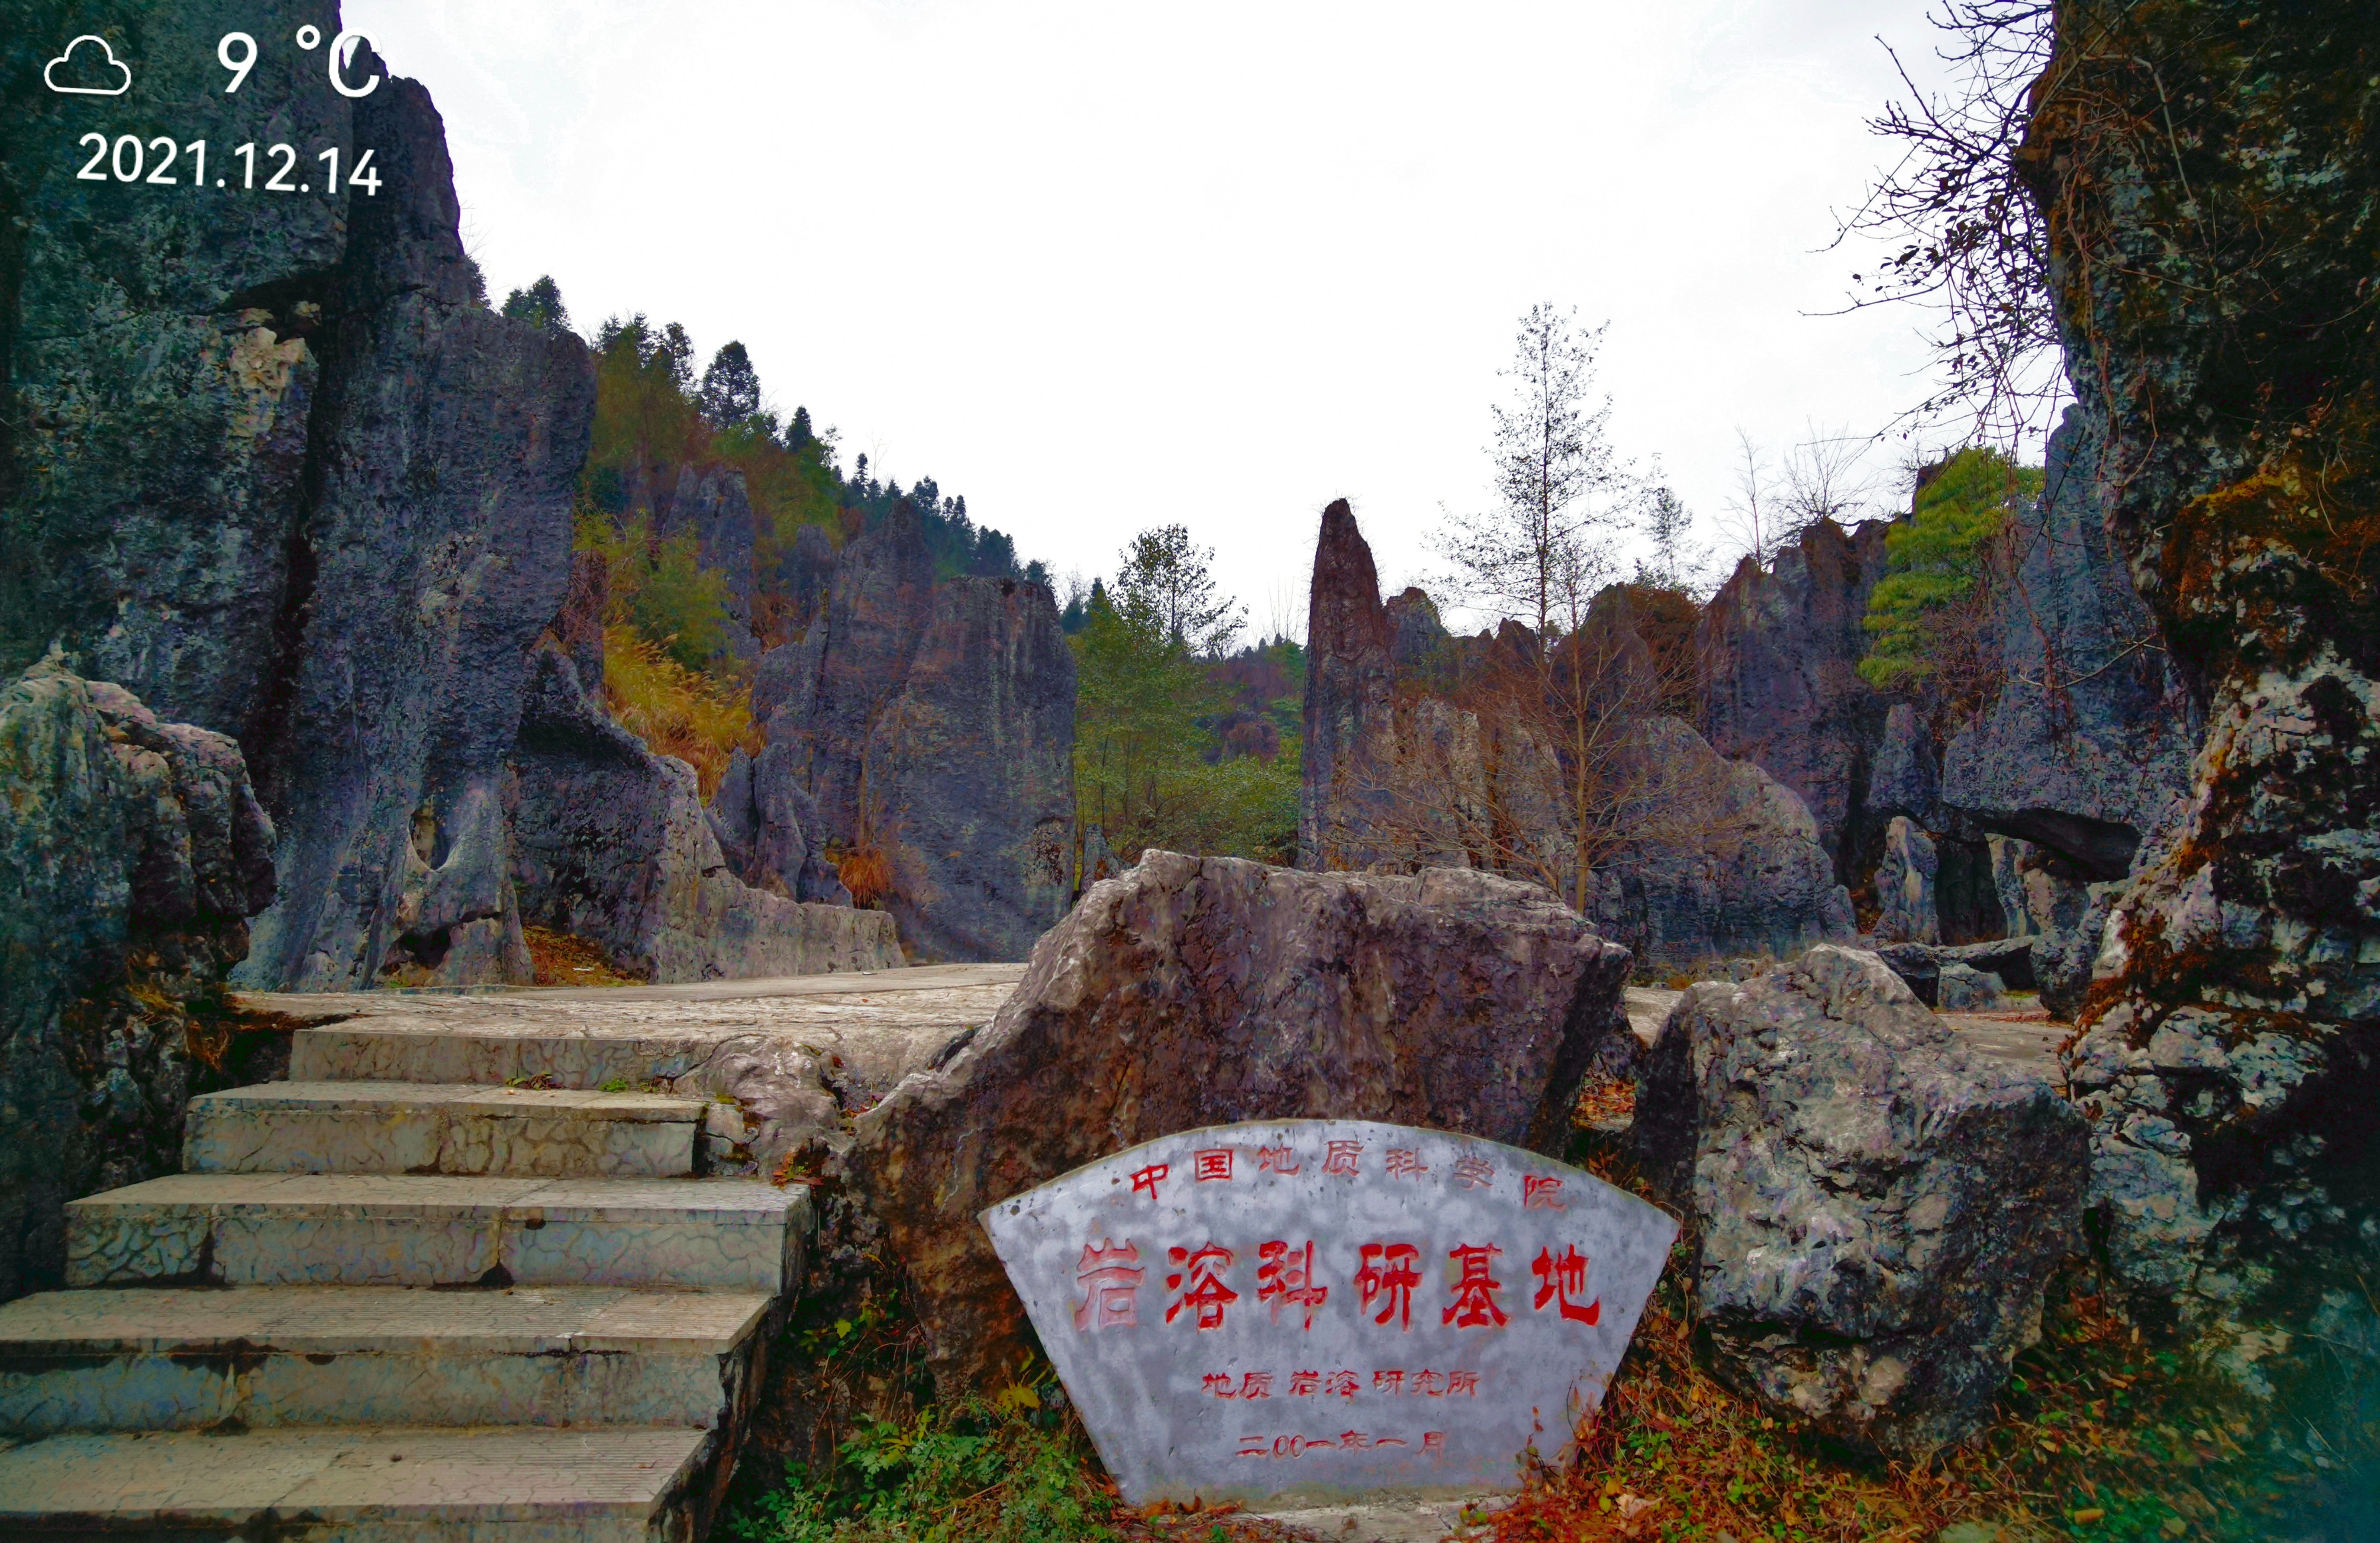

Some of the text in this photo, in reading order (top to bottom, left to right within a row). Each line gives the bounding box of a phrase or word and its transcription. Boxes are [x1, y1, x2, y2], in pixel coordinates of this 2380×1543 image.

[1128, 1140, 1567, 1212] 中国地质科学院
[1074, 1236, 1600, 1334] 岩溶科研基地
